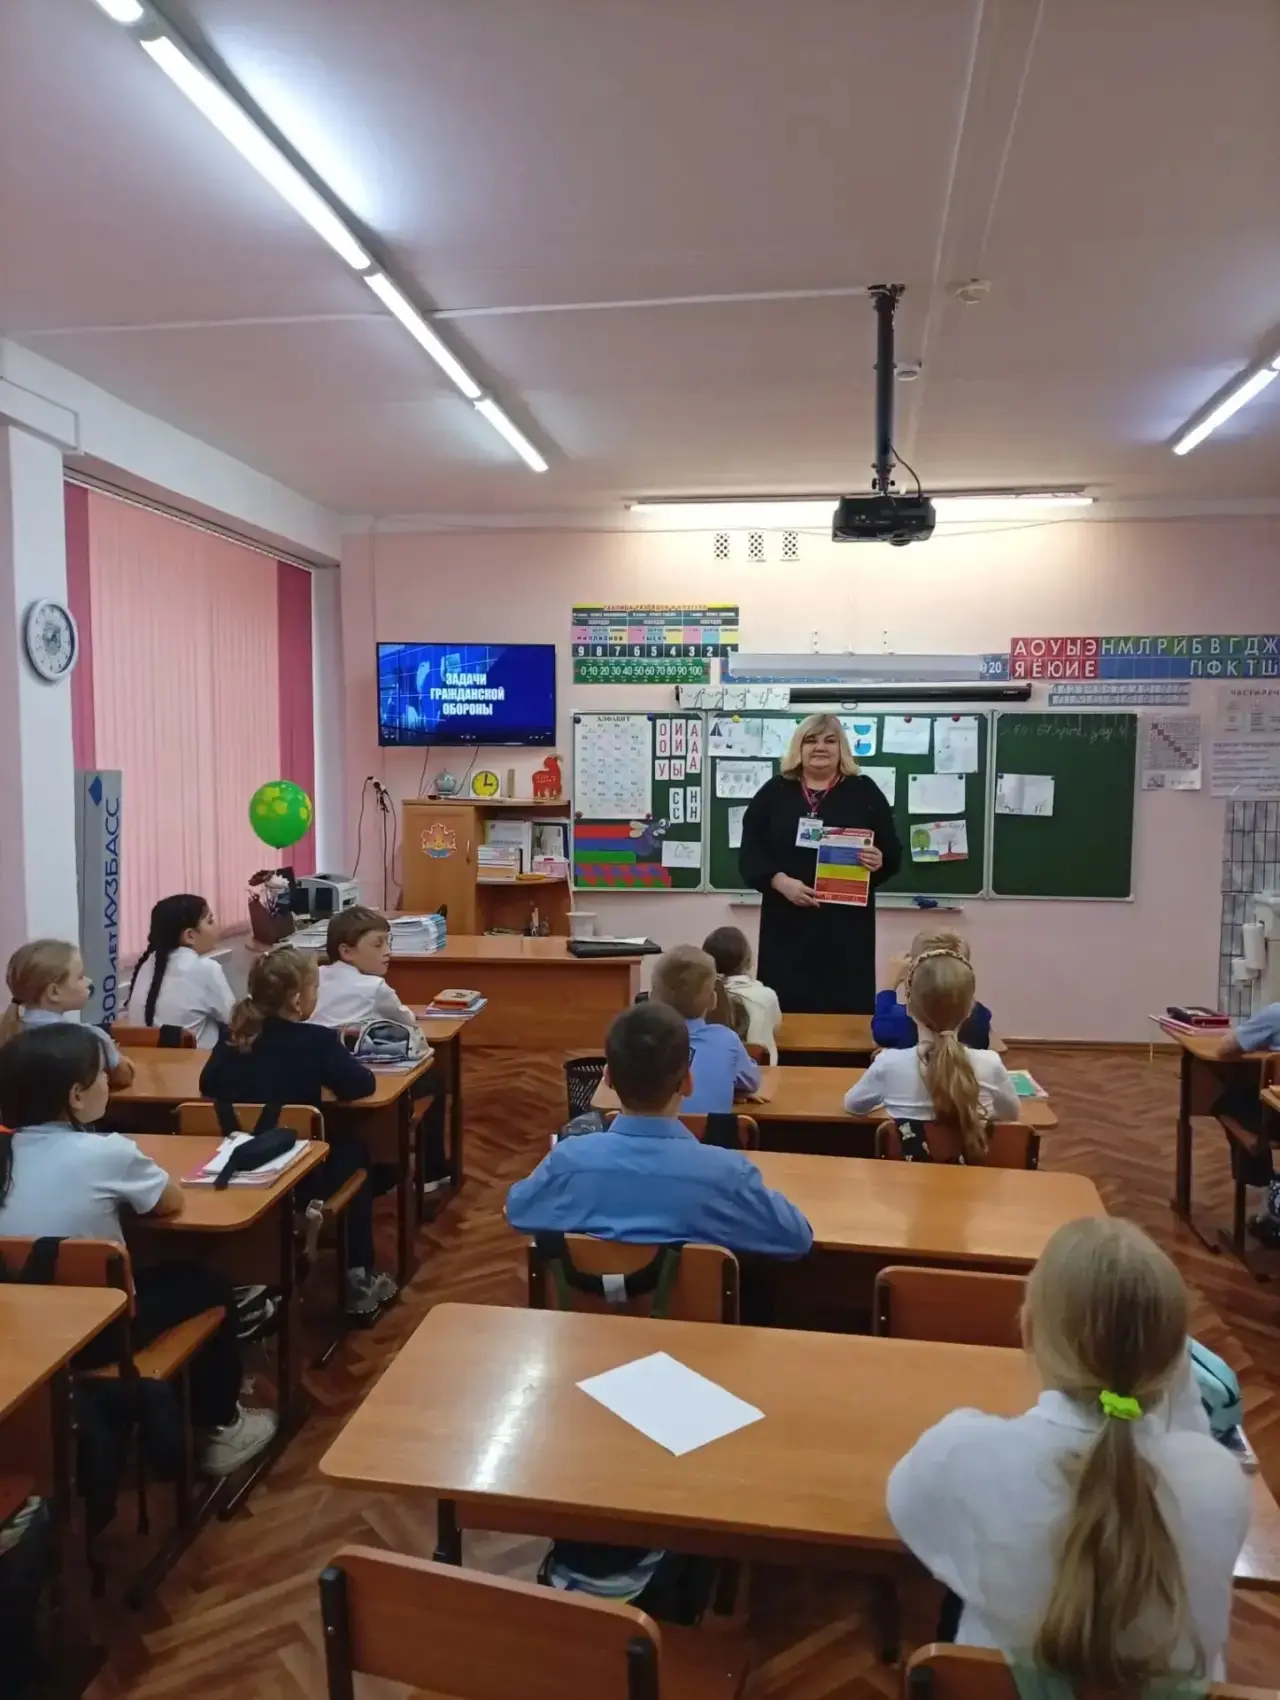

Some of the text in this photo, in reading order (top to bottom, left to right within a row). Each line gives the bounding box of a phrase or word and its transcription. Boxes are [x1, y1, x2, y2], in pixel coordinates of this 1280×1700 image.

[578, 646, 584, 657] 9
[596, 646, 602, 657] 8
[614, 646, 621, 657] 7
[634, 646, 640, 657] 6
[651, 646, 657, 657] 5
[670, 646, 676, 657] 4
[688, 646, 695, 657] 3
[707, 646, 713, 657] 2
[589, 666, 598, 676] 10
[600, 666, 609, 676] 20
[612, 666, 621, 676] 30
[622, 666, 632, 676] 40
[634, 666, 644, 676] 50
[645, 666, 654, 676] 60
[656, 666, 665, 676] 70
[667, 666, 676, 676] 80
[677, 666, 687, 676] 90
[689, 666, 702, 676] 100
[989, 661, 1001, 673] 20
[446, 673, 487, 687] ЗАДАЧИ
[430, 686, 505, 701] ГРАЖДАНСКОЙ
[442, 703, 493, 715] ОБОРОНЫ
[659, 764, 682, 776] У Ы
[104, 797, 119, 928] КУЗБАСС
[108, 932, 117, 973] ЛЕТ
